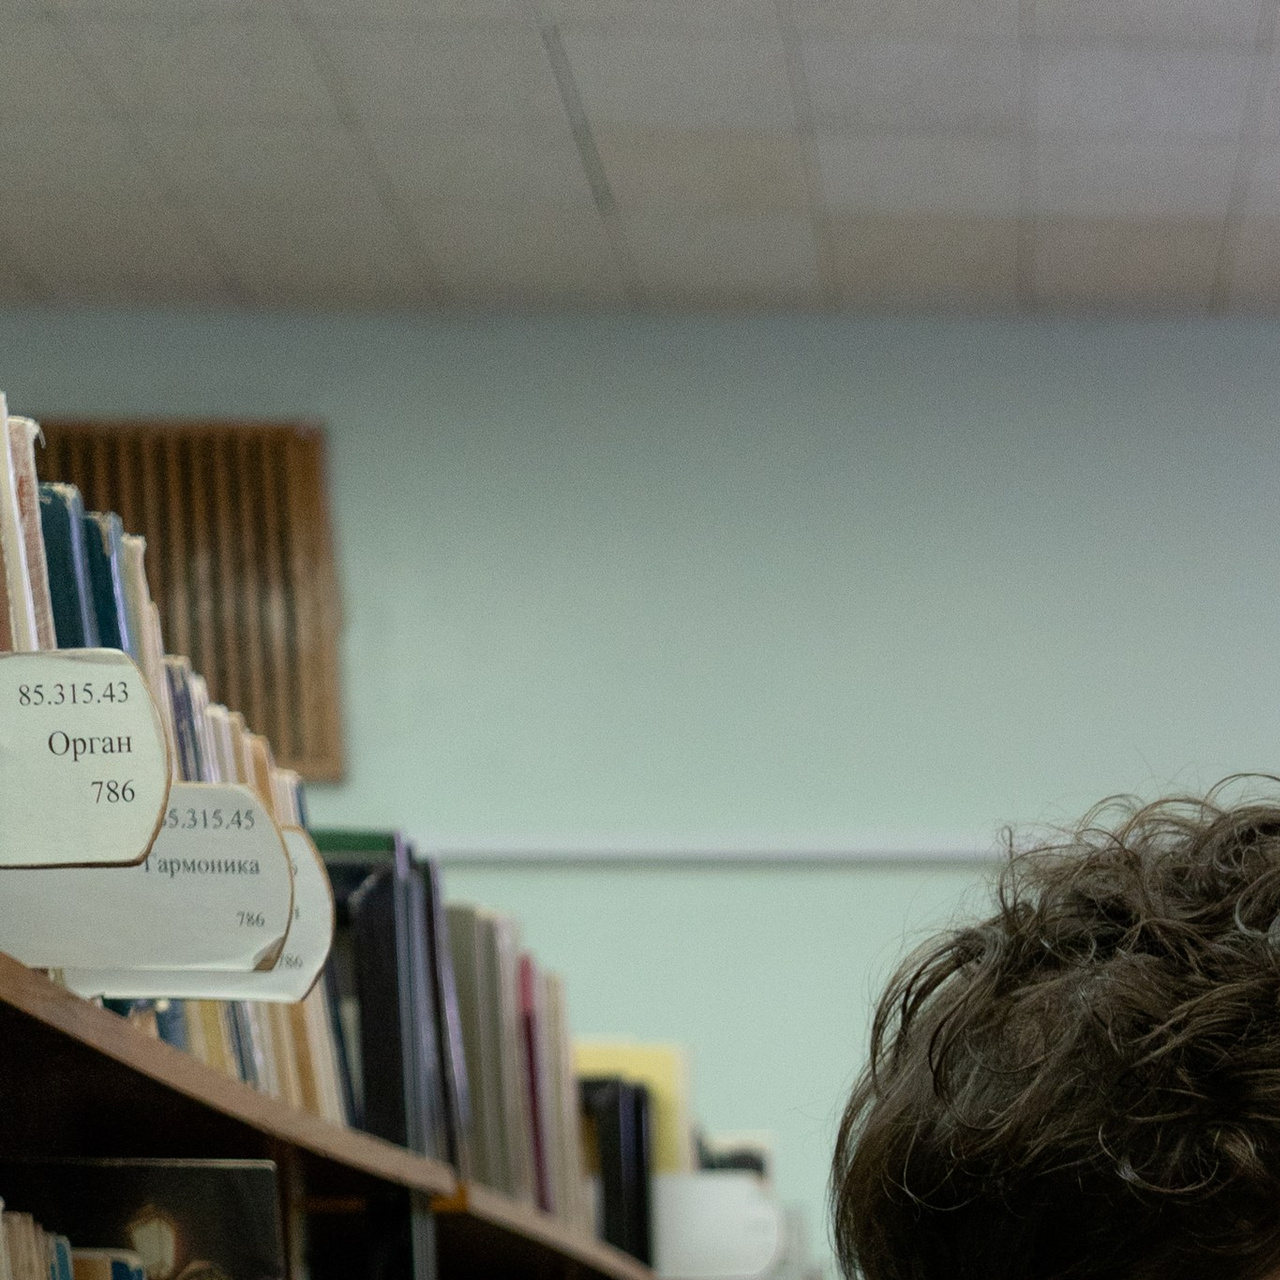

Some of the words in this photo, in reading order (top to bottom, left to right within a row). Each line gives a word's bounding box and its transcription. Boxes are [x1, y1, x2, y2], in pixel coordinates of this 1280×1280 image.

[18, 681, 129, 706] 85.315.43
[48, 730, 132, 762] Орган
[90, 779, 136, 804] 786
[163, 808, 255, 830] 5.315.45
[236, 910, 265, 927] 786
